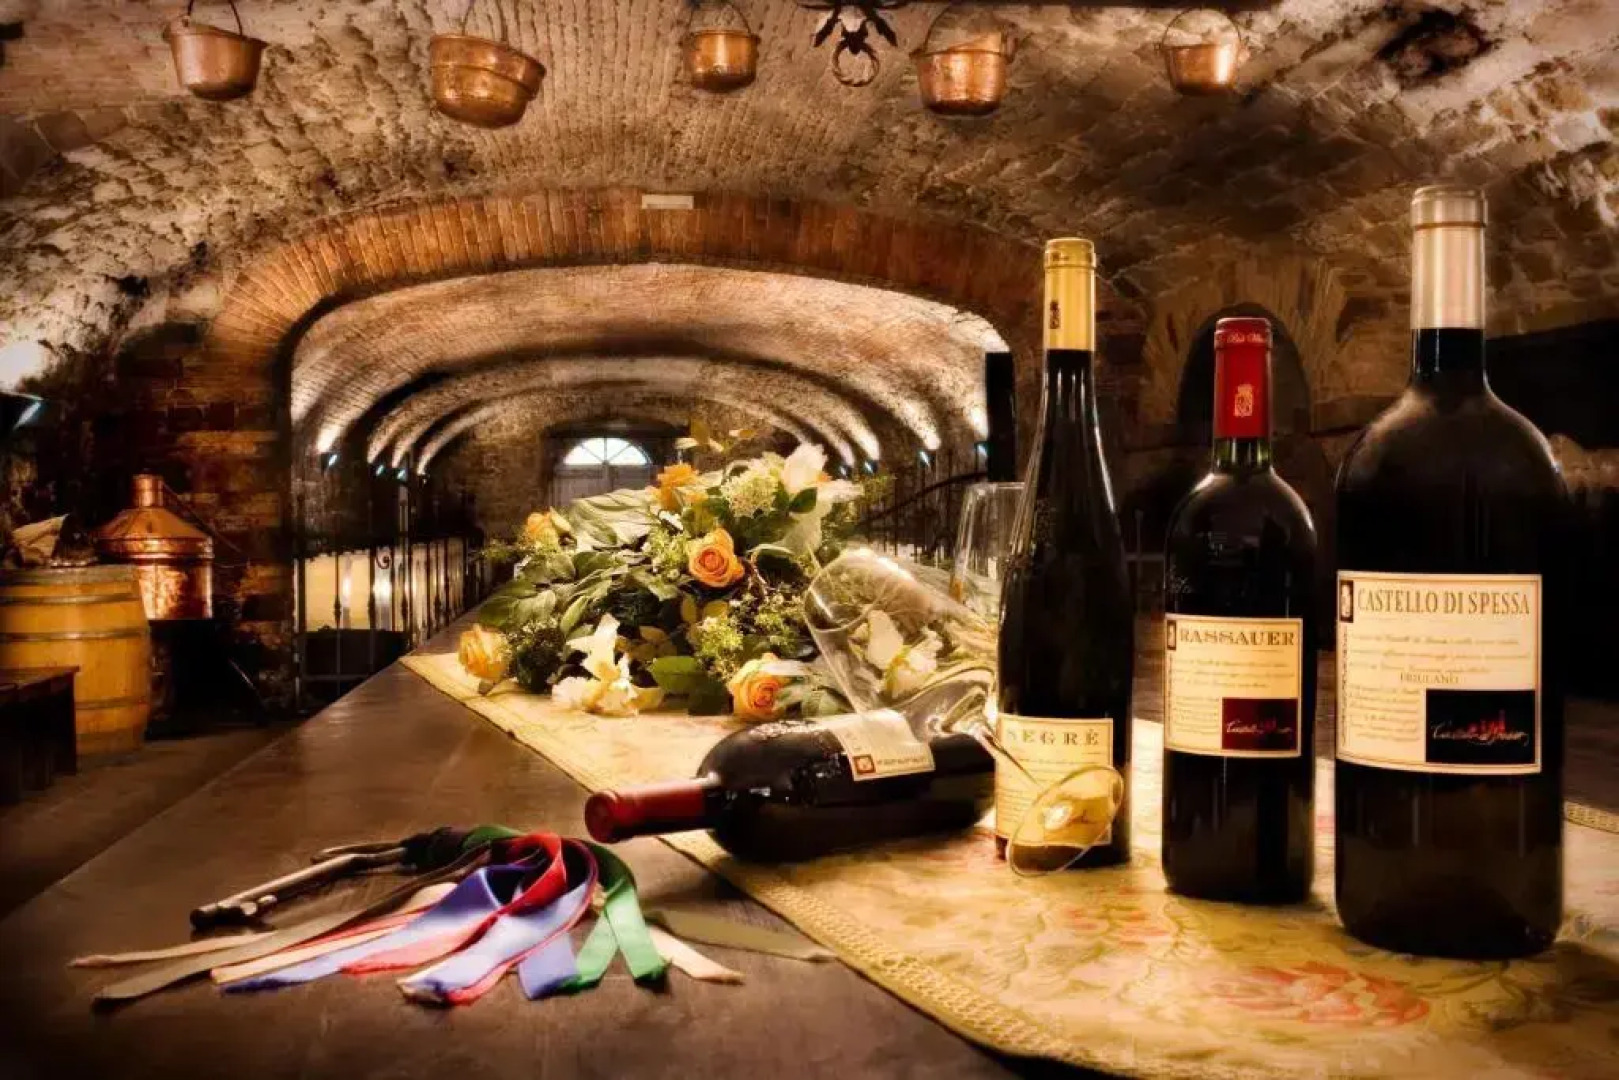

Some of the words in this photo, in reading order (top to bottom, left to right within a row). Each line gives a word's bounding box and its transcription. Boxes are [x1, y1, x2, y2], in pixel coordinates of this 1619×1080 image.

[1357, 588, 1438, 613] CASTELLO
[1443, 591, 1464, 614] DI
[1468, 591, 1530, 615] SPESSA
[1180, 628, 1294, 646] RASSAUER
